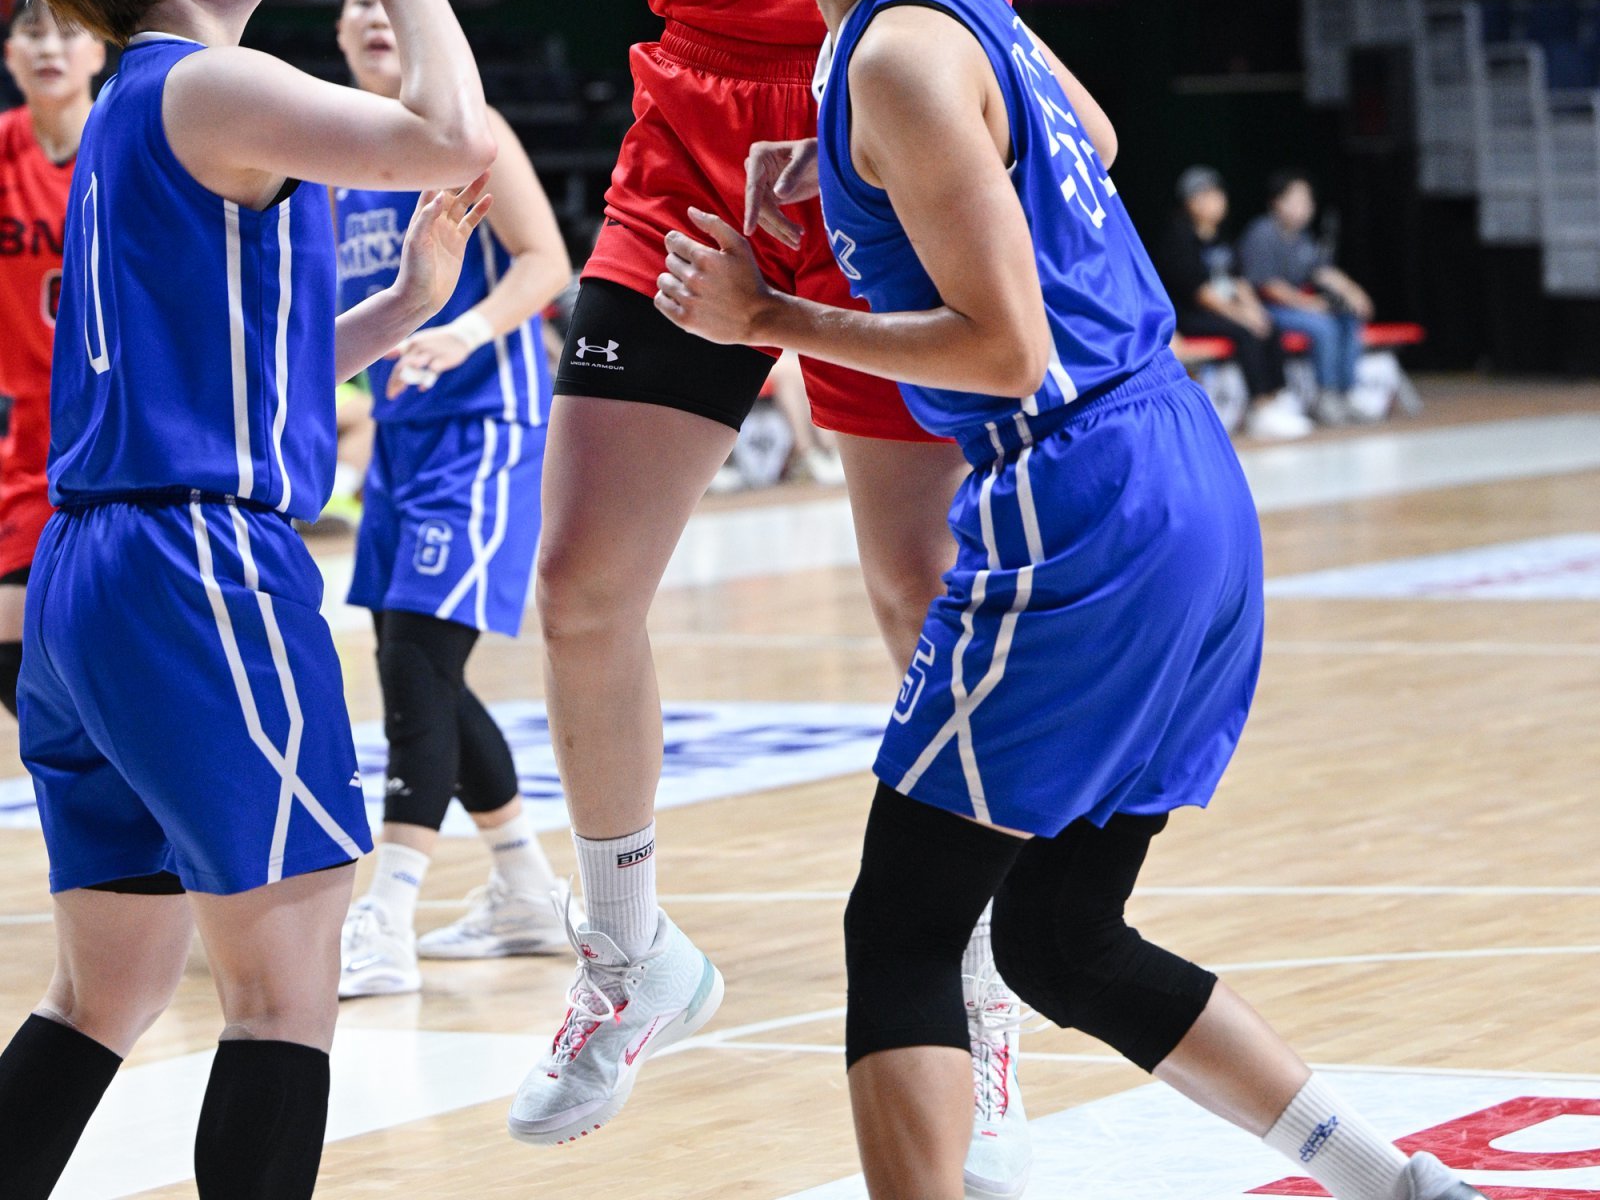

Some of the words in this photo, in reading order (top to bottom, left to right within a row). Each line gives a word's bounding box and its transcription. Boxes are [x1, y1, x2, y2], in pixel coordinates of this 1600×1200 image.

[0, 216, 66, 257] BN
[591, 362, 625, 371] ARMOUR
[412, 519, 454, 576] 6
